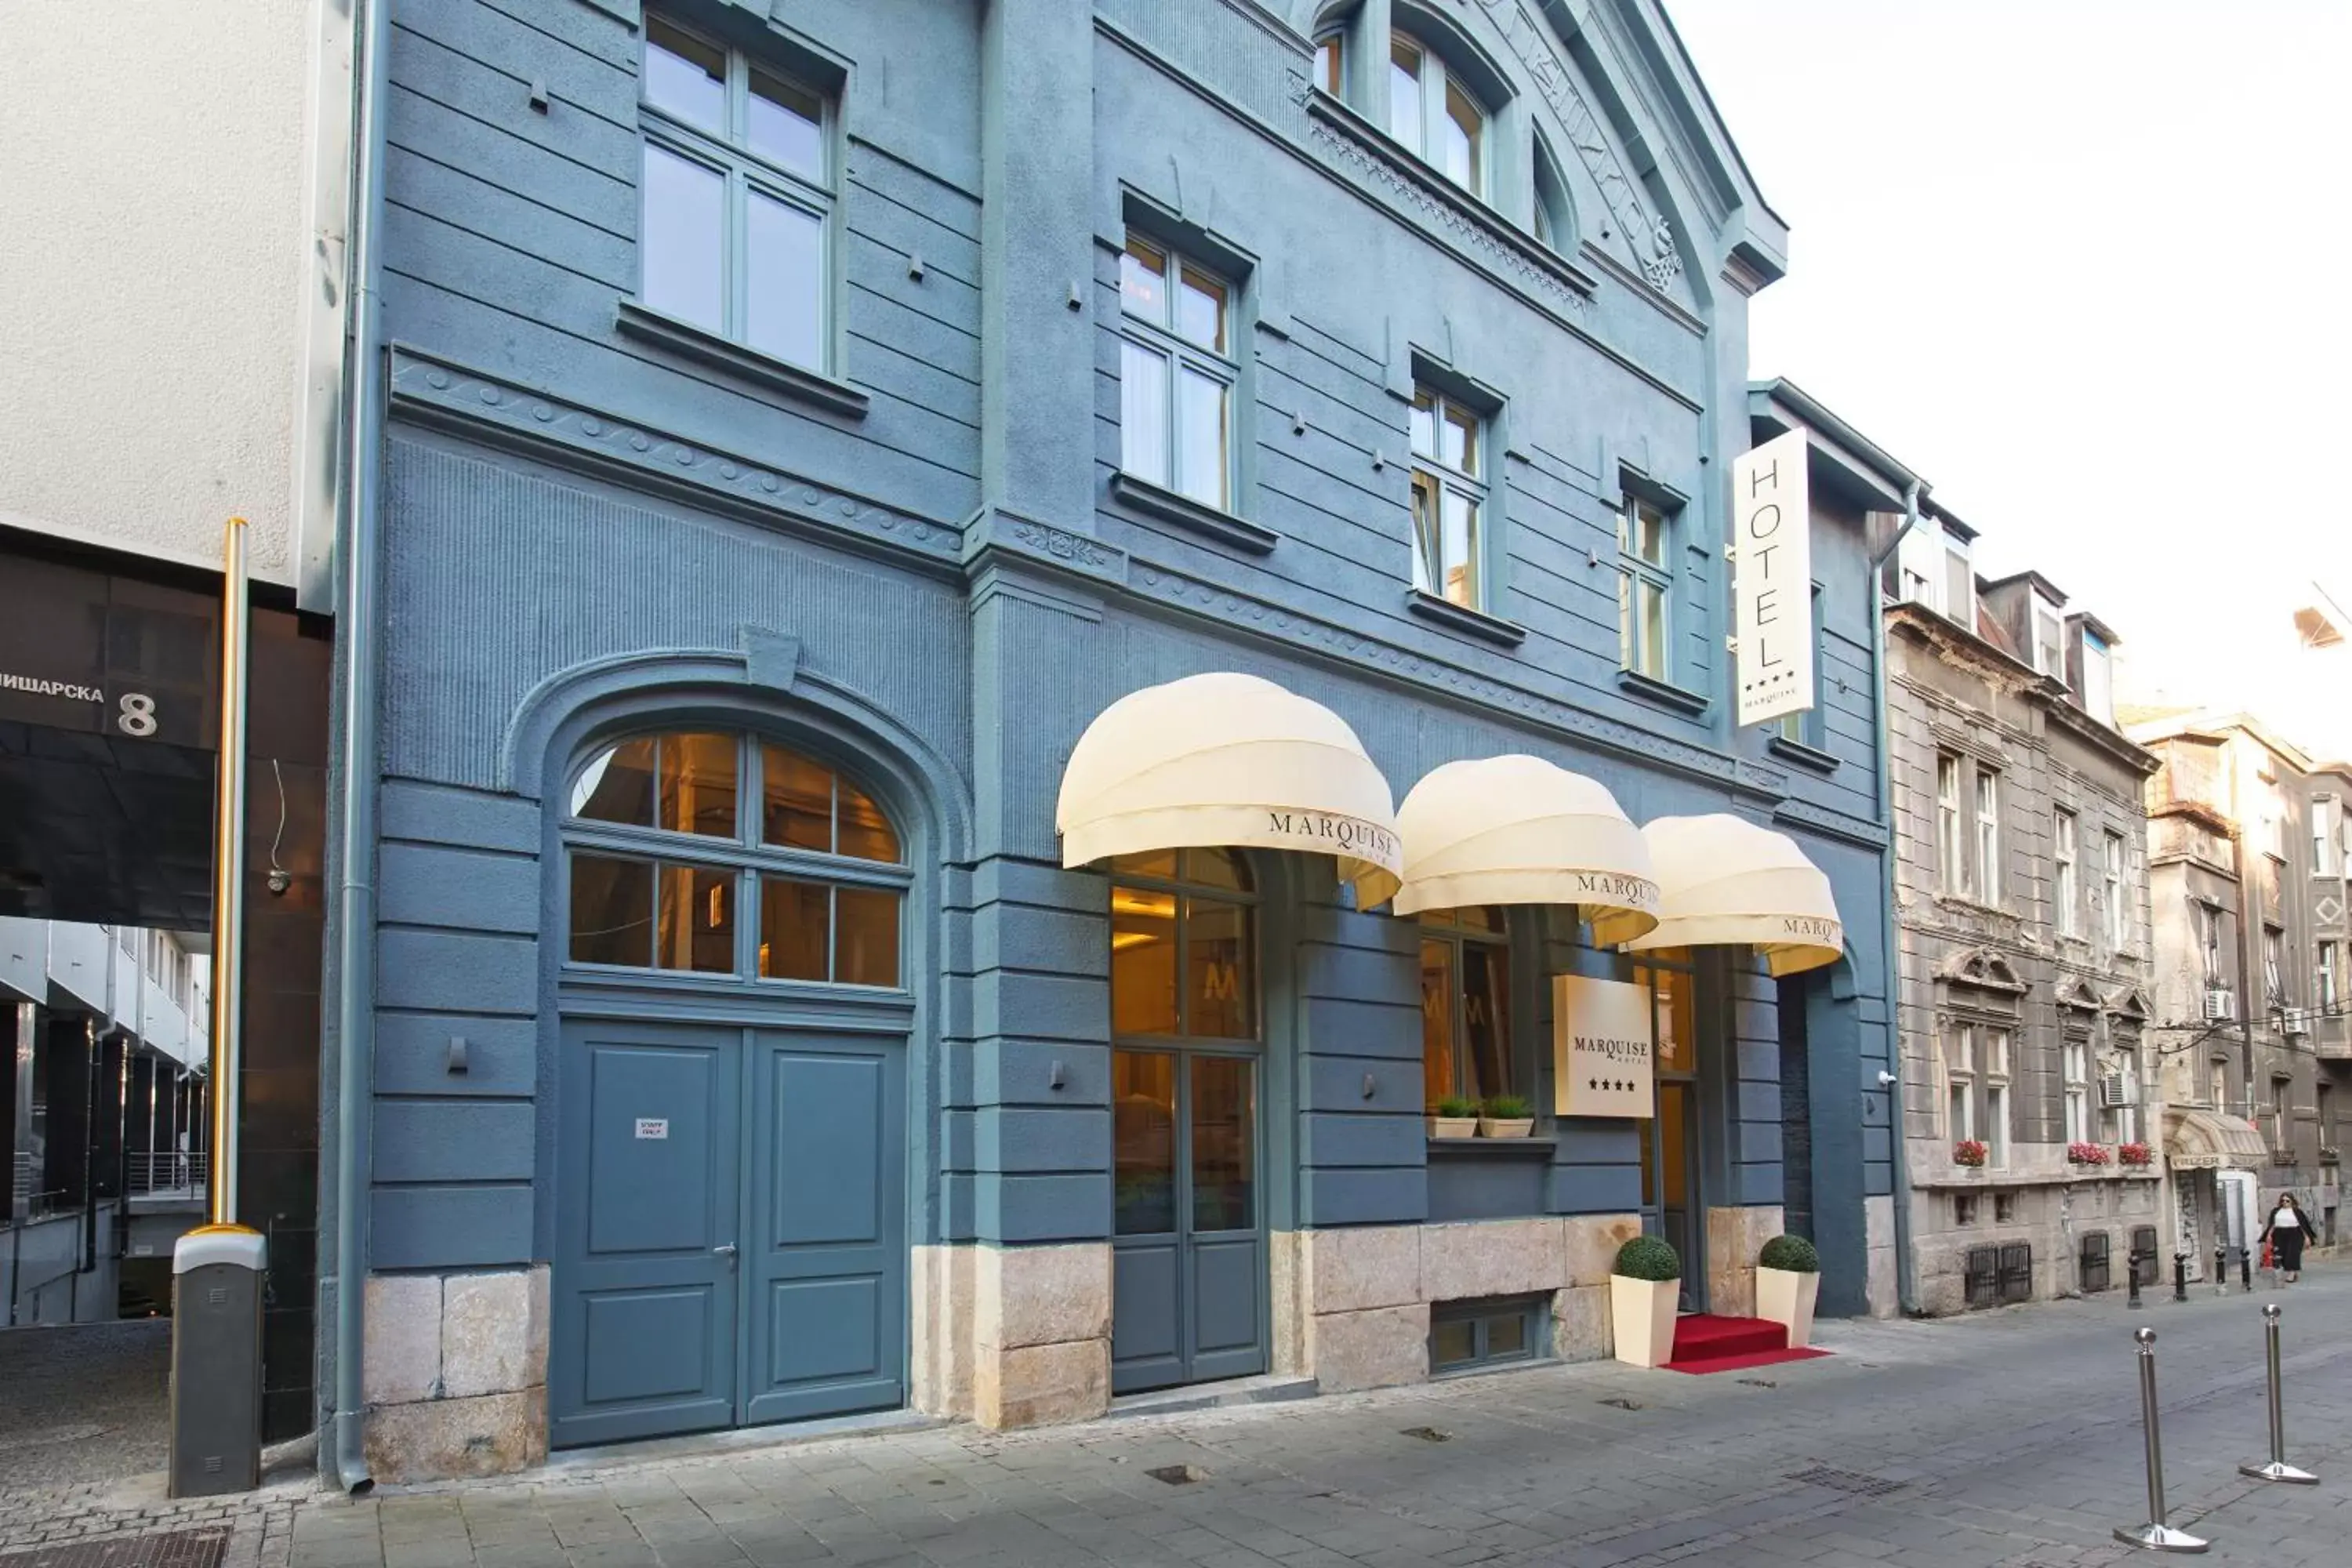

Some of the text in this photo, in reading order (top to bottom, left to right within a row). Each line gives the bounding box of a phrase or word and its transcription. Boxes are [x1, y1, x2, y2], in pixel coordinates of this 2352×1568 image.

[1751, 458, 1782, 667] HOTEL
[119, 693, 158, 736] 8
[1745, 688, 1795, 708] MARQUISE
[1269, 813, 1393, 855] MARQUISE
[1574, 1036, 1648, 1060] MARQUISE
